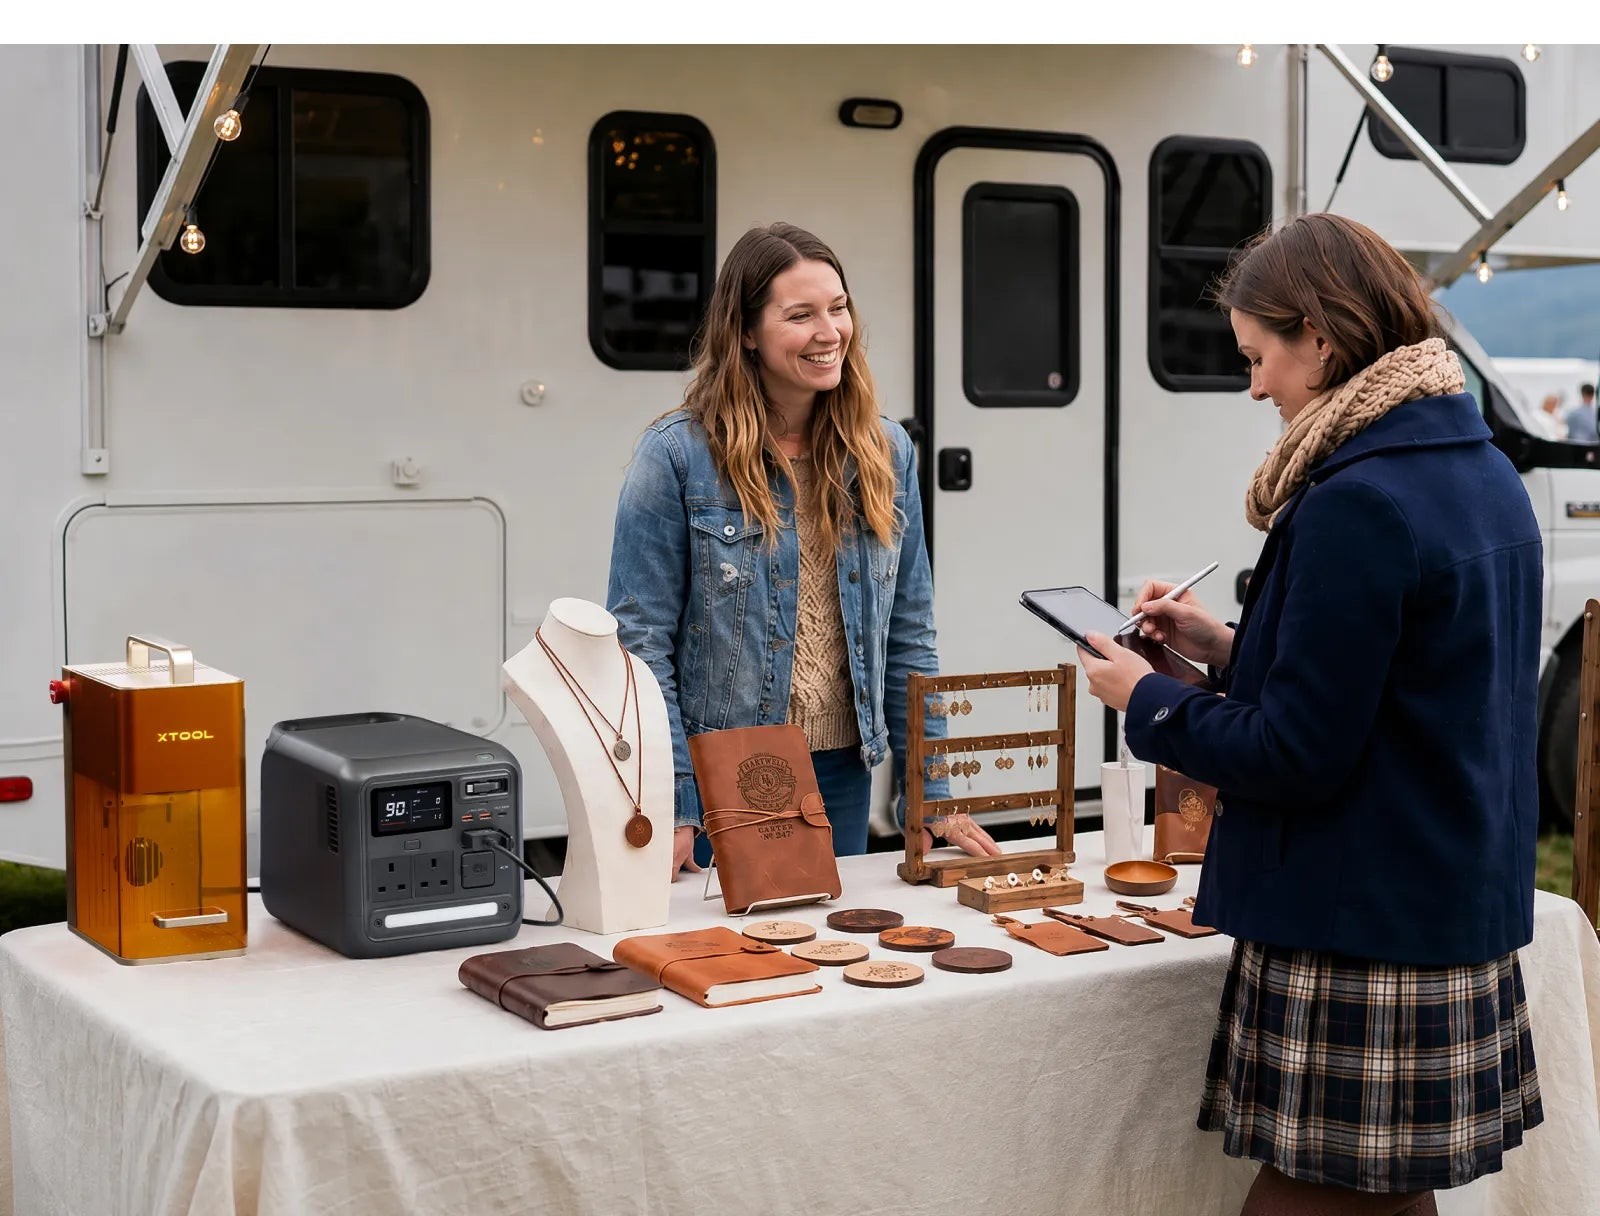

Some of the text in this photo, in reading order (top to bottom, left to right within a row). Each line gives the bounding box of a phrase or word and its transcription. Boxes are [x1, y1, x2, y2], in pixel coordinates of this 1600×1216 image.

[157, 730, 214, 742] XTOOL
[743, 758, 785, 771] HARTWELL
[758, 824, 793, 833] CARTER
